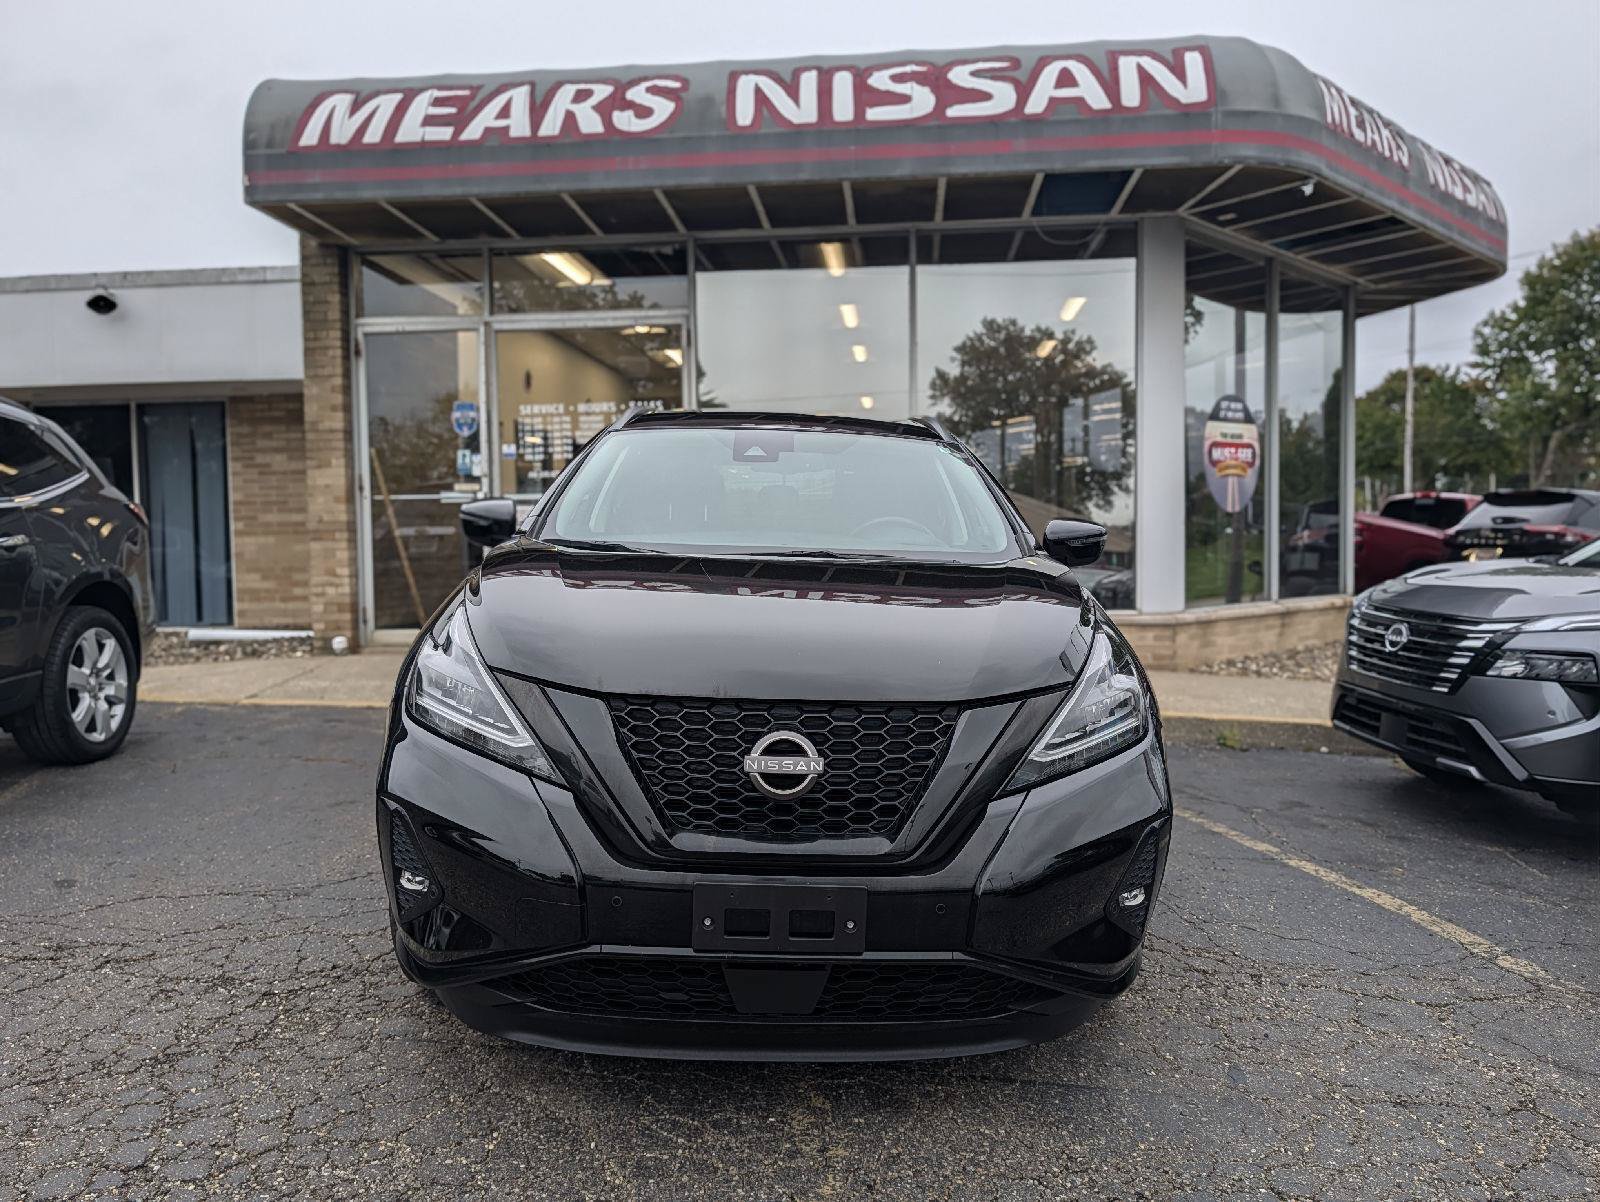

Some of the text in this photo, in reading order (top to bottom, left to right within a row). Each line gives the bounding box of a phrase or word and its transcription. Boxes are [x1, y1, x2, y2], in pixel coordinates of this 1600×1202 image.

[298, 50, 1210, 147] MEARS NISSAN
[1319, 79, 1410, 168] MEARS
[746, 760, 823, 771] NISSAN
